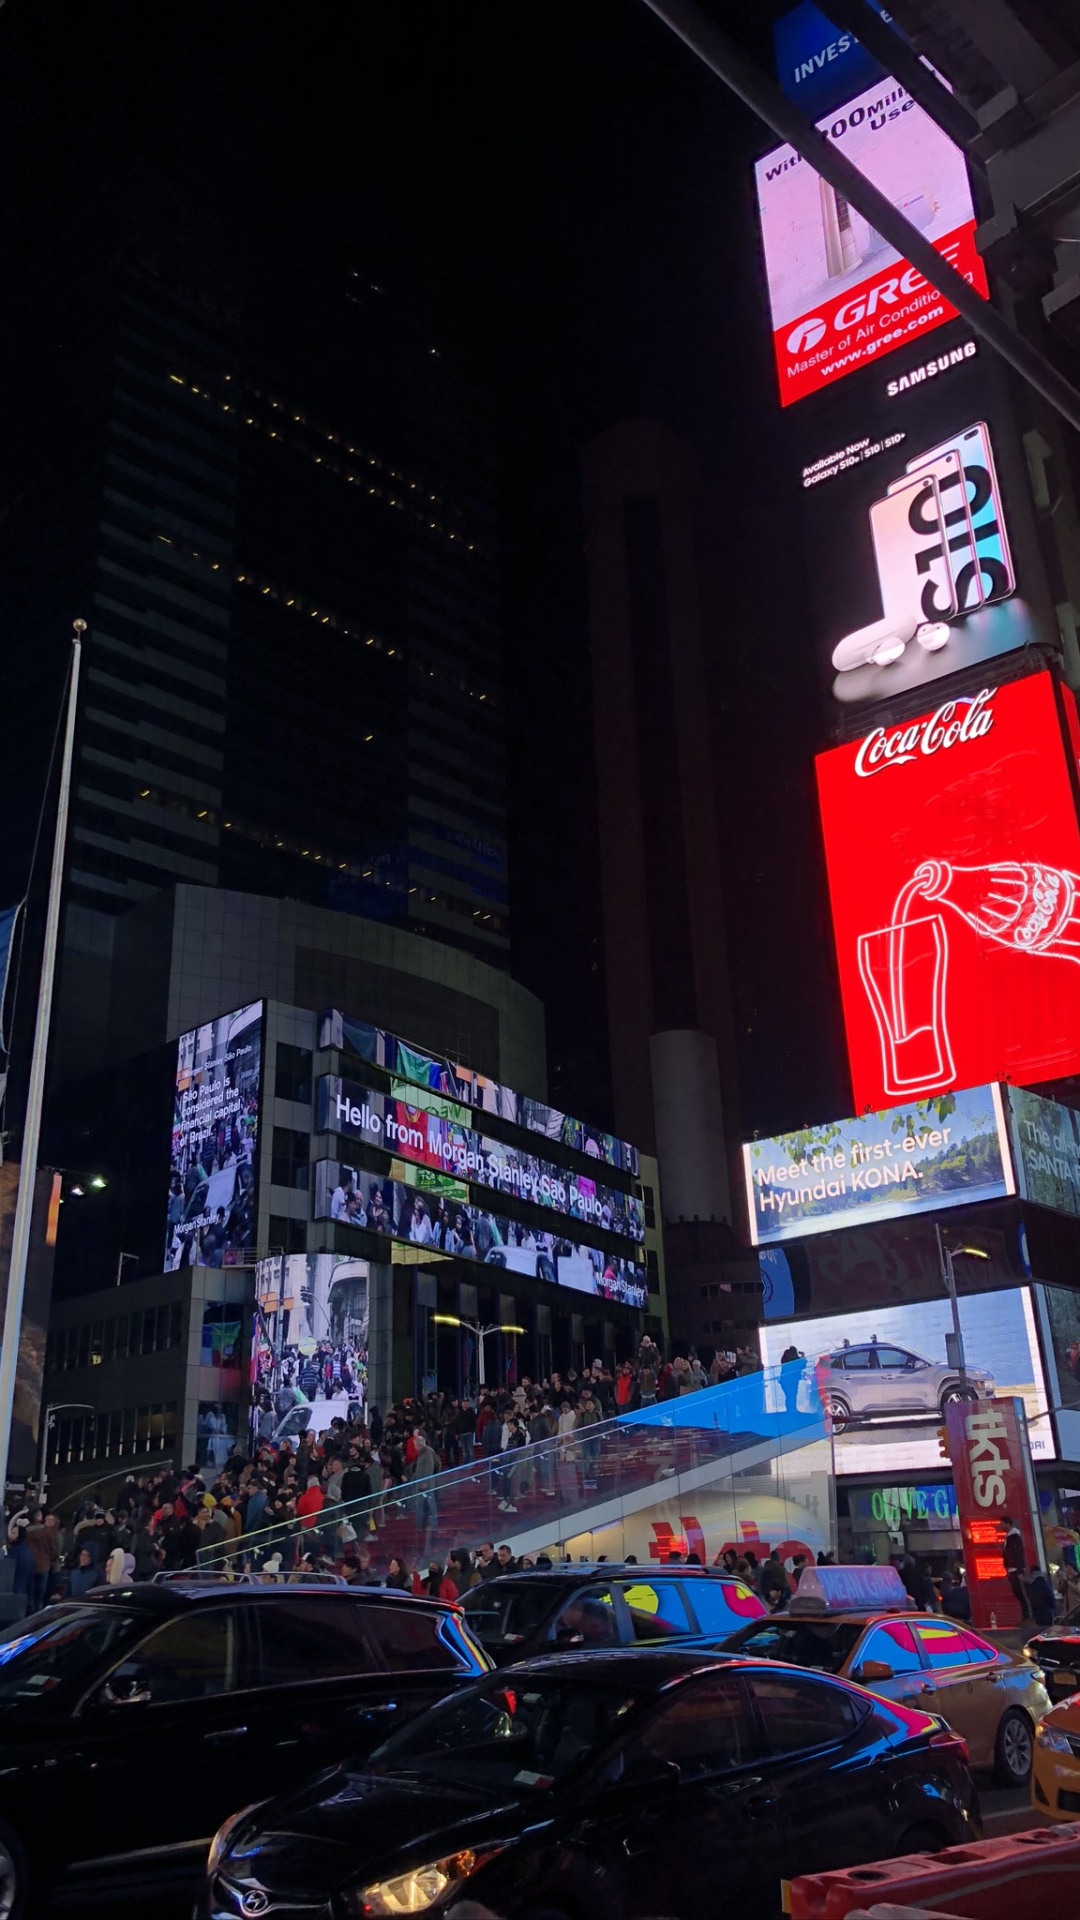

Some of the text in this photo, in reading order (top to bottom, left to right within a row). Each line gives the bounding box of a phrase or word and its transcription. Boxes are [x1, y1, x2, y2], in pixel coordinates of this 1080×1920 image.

[787, 347, 834, 378] Master
[838, 335, 852, 351] of
[856, 324, 875, 342] Air
[820, 306, 944, 376] www.gree.com
[886, 341, 977, 397] SAMSUNG
[803, 438, 870, 478] Available Now
[803, 464, 839, 488] Galaxy
[864, 443, 881, 458] S10
[908, 464, 1012, 622] S10
[182, 1076, 231, 1104] São Paulo is
[182, 1087, 240, 1117] considered the
[179, 1133, 188, 1147] of
[180, 1099, 241, 1132] financial capital
[1023, 1120, 1050, 1148] The
[336, 1094, 603, 1217] Hello from Morgan Stanley São Paulo
[757, 1127, 952, 1187] Meet the first-ever
[1028, 1148, 1074, 1183] SANTA
[759, 1160, 924, 1213] Hyundai KONA.
[965, 1408, 1011, 1508] tkts
